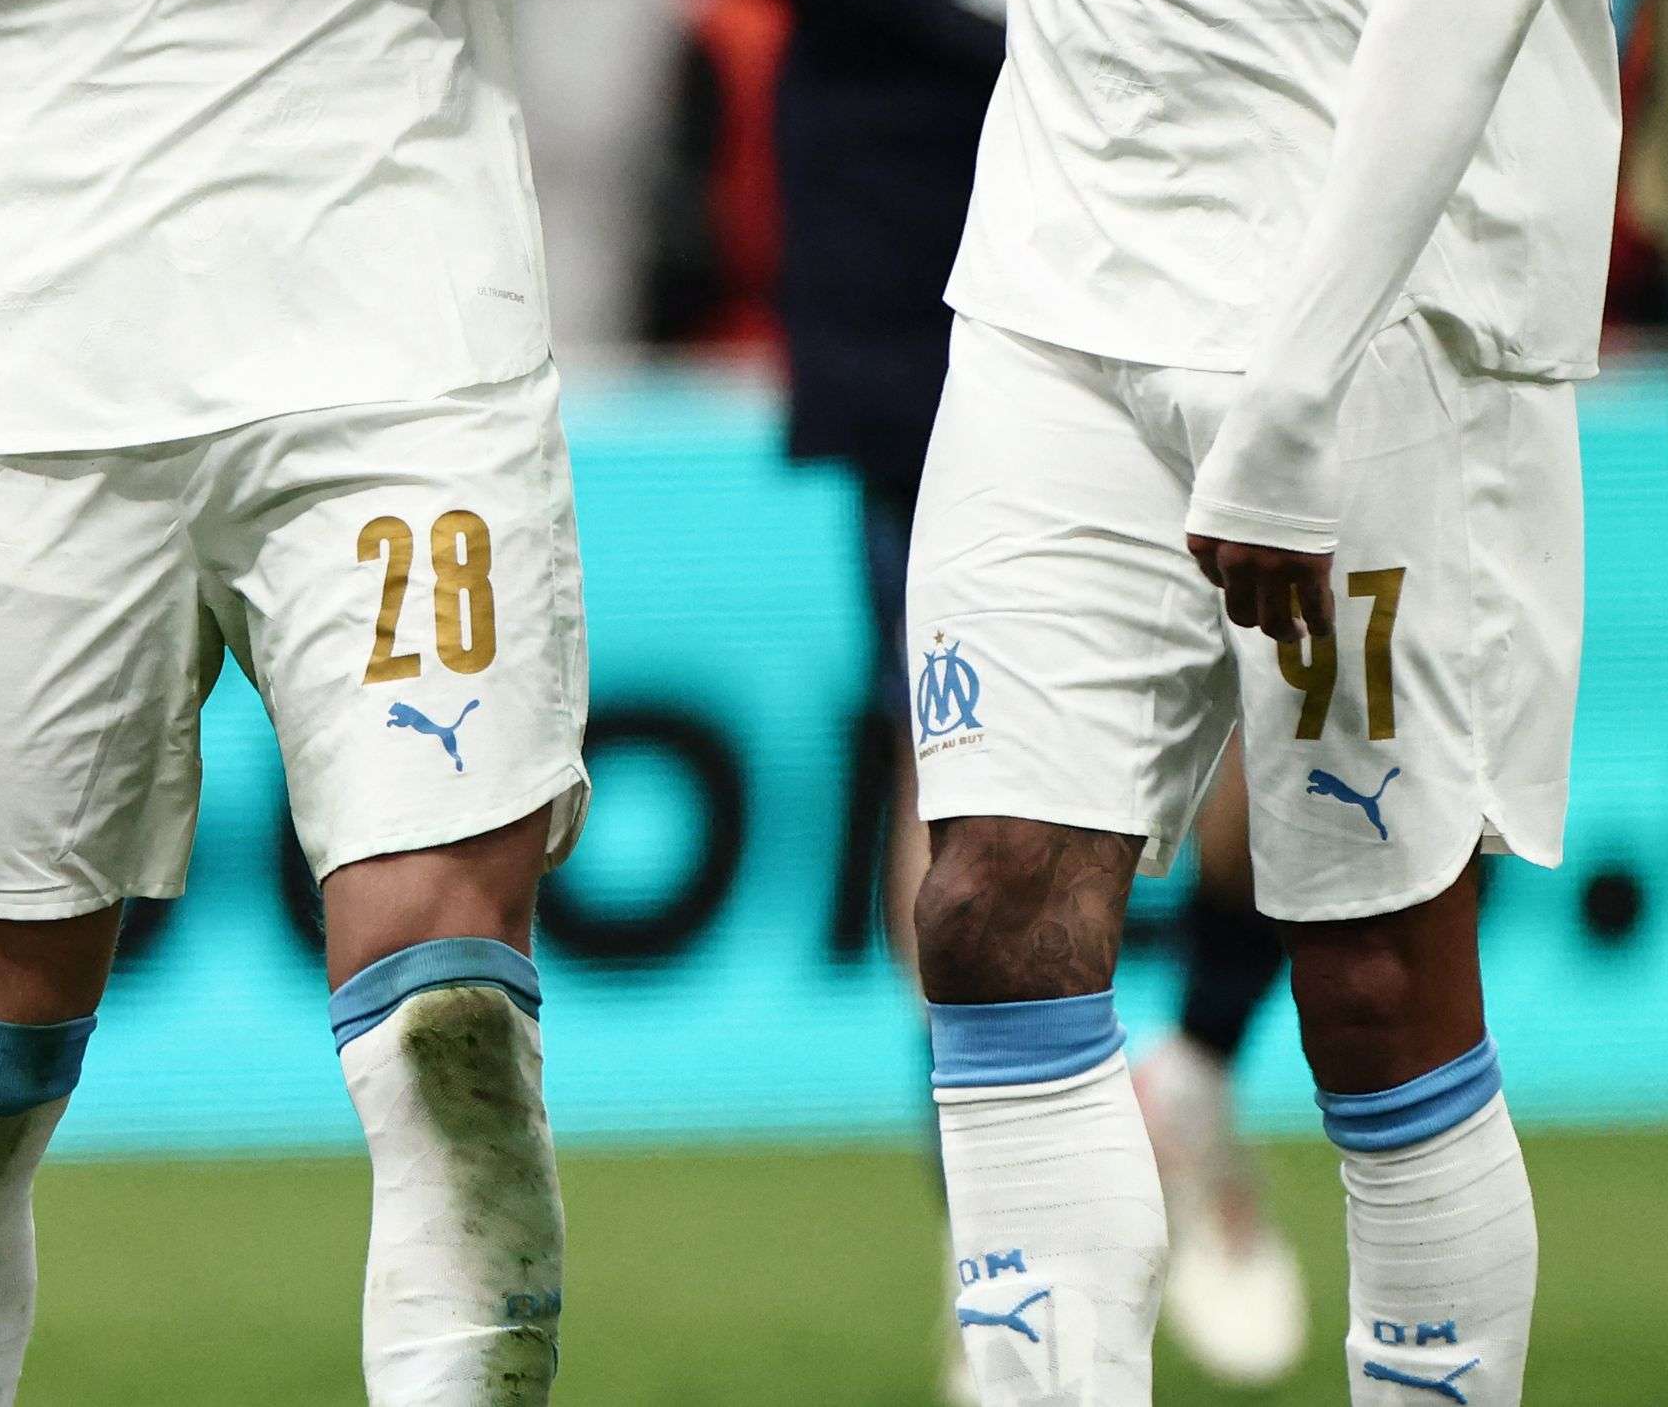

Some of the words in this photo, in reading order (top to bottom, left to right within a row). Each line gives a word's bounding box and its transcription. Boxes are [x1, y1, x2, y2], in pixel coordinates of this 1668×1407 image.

[356, 509, 498, 687] 28
[1277, 567, 1407, 741] 97
[959, 734, 985, 746] BUT
[959, 1247, 1028, 1287] OM
[1373, 1318, 1458, 1348] OM
